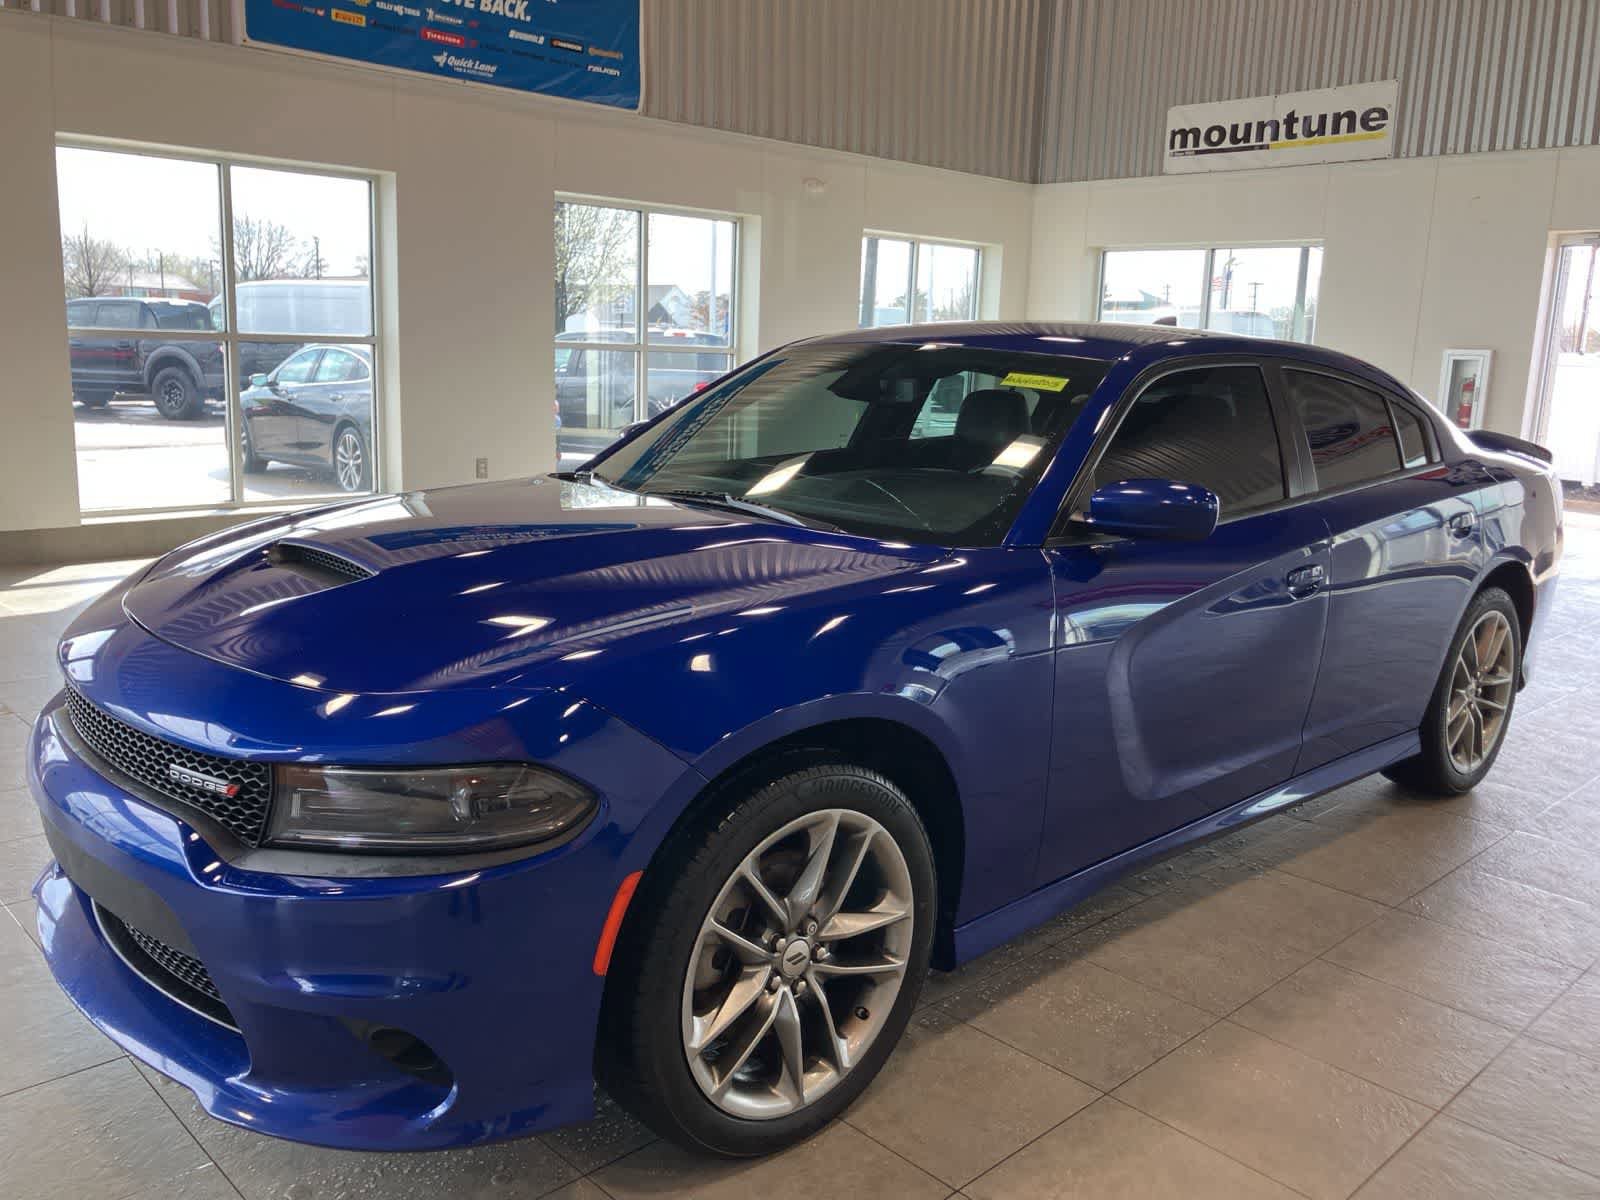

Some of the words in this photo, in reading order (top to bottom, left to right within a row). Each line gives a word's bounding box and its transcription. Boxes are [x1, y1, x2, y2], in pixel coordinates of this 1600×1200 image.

[479, 0, 531, 21] BACK.
[447, 56, 474, 69] Quick
[474, 60, 497, 73] Lane
[1169, 106, 1389, 150] mountune
[169, 769, 228, 794] DODGE
